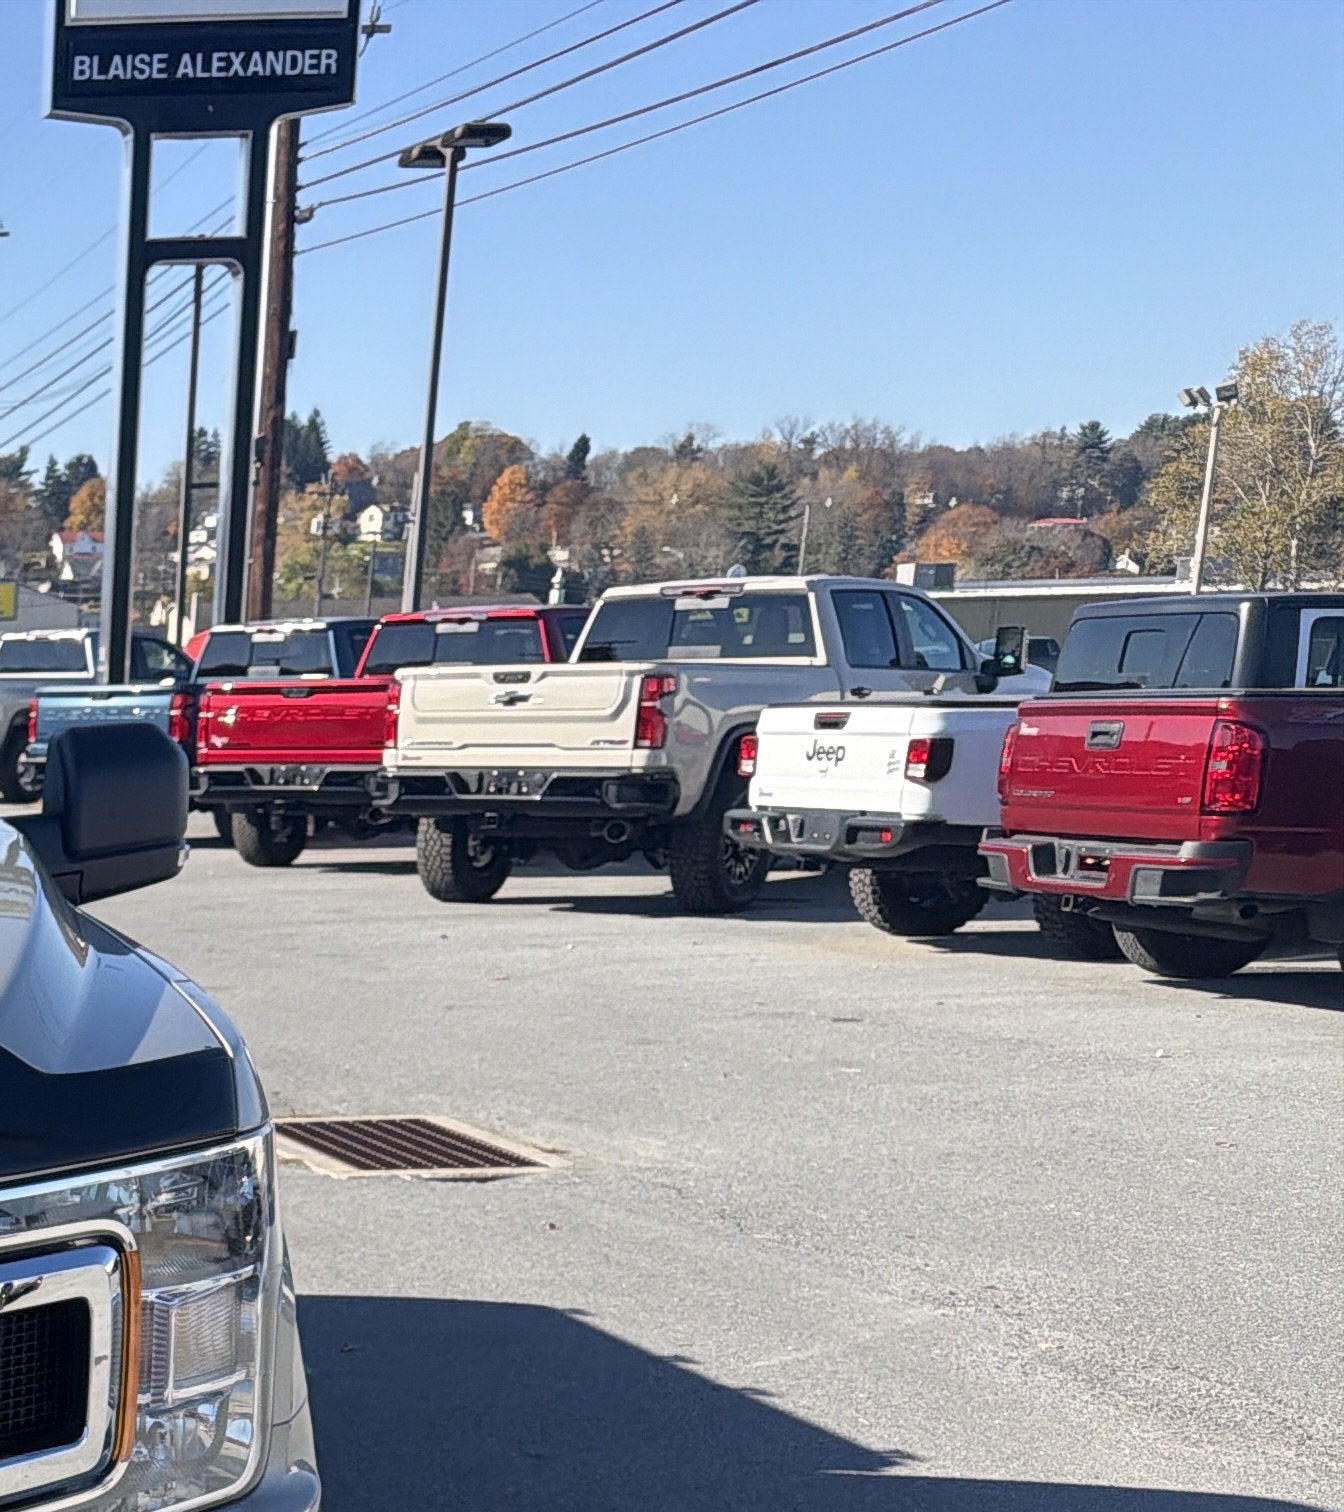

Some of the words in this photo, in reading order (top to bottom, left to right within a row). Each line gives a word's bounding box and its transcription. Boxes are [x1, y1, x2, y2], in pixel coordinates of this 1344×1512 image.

[72, 53, 169, 81] BLAISE
[176, 48, 339, 79] ALEXANDER
[805, 738, 846, 767] Jeep
[1017, 755, 1197, 776] CHEVROLET
